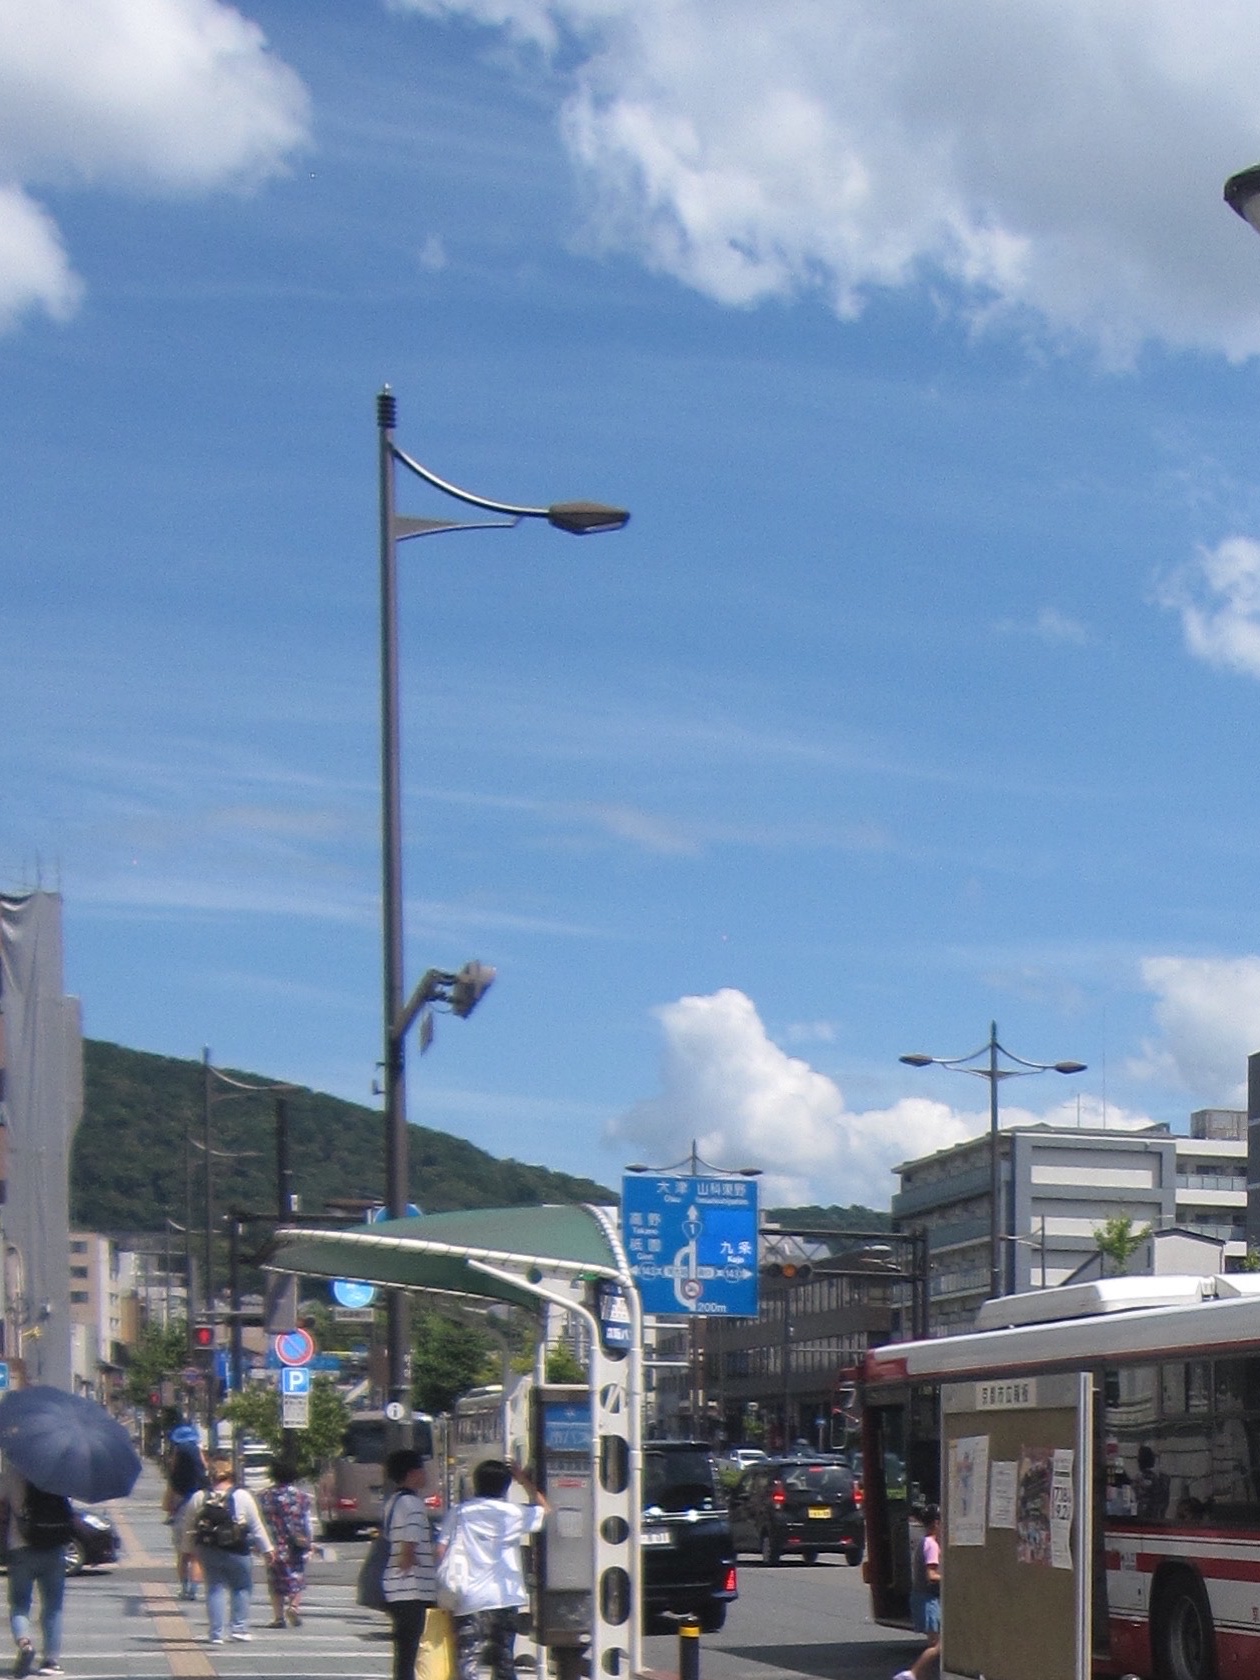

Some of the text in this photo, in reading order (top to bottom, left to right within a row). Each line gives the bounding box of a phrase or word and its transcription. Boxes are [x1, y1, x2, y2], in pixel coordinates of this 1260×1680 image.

[720, 1241, 752, 1255] 九条
[698, 1302, 727, 1313] 200m
[290, 1371, 304, 1391] P
